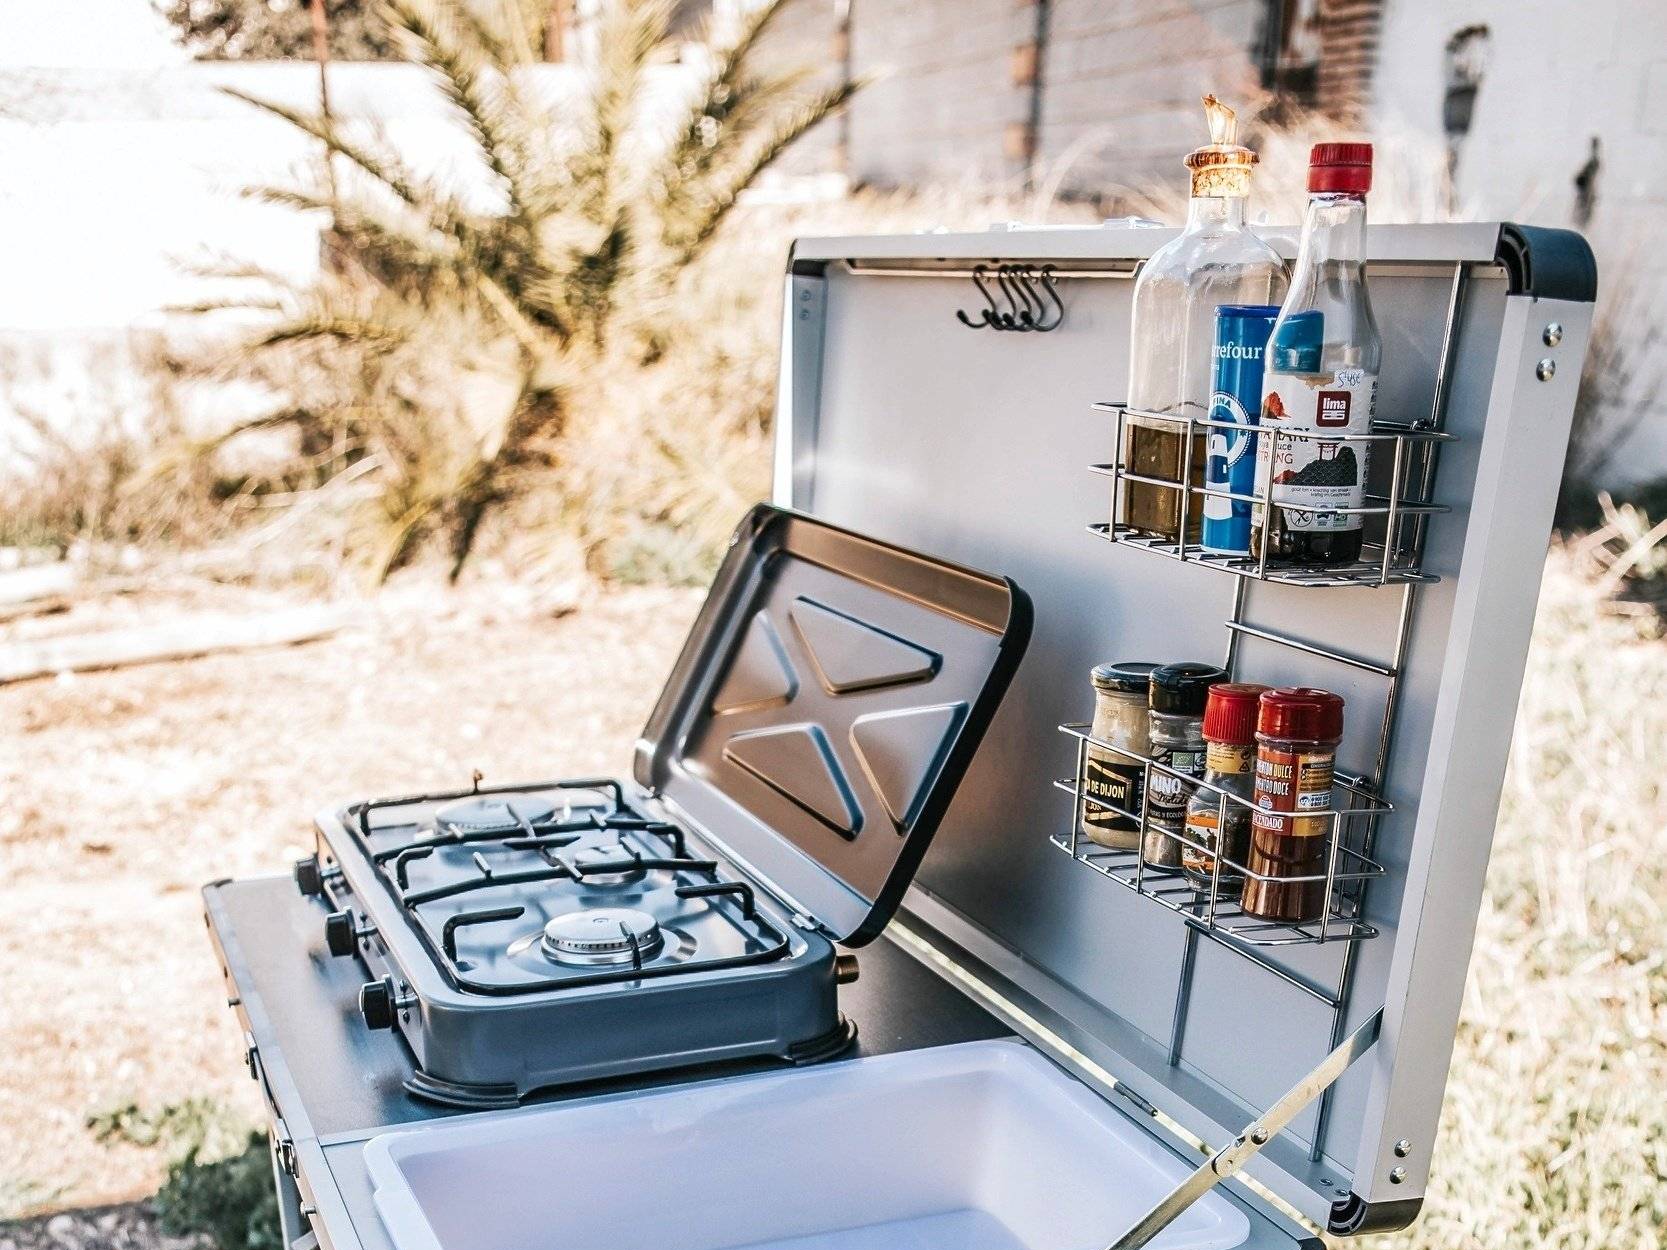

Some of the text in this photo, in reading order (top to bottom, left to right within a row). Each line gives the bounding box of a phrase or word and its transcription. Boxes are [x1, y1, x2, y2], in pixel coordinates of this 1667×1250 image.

[1322, 397, 1347, 410] lima
[1273, 763, 1293, 779] DULCE
[1090, 779, 1100, 795] DE
[1100, 782, 1125, 800] DIJON
[1273, 780, 1290, 796] DOCE
